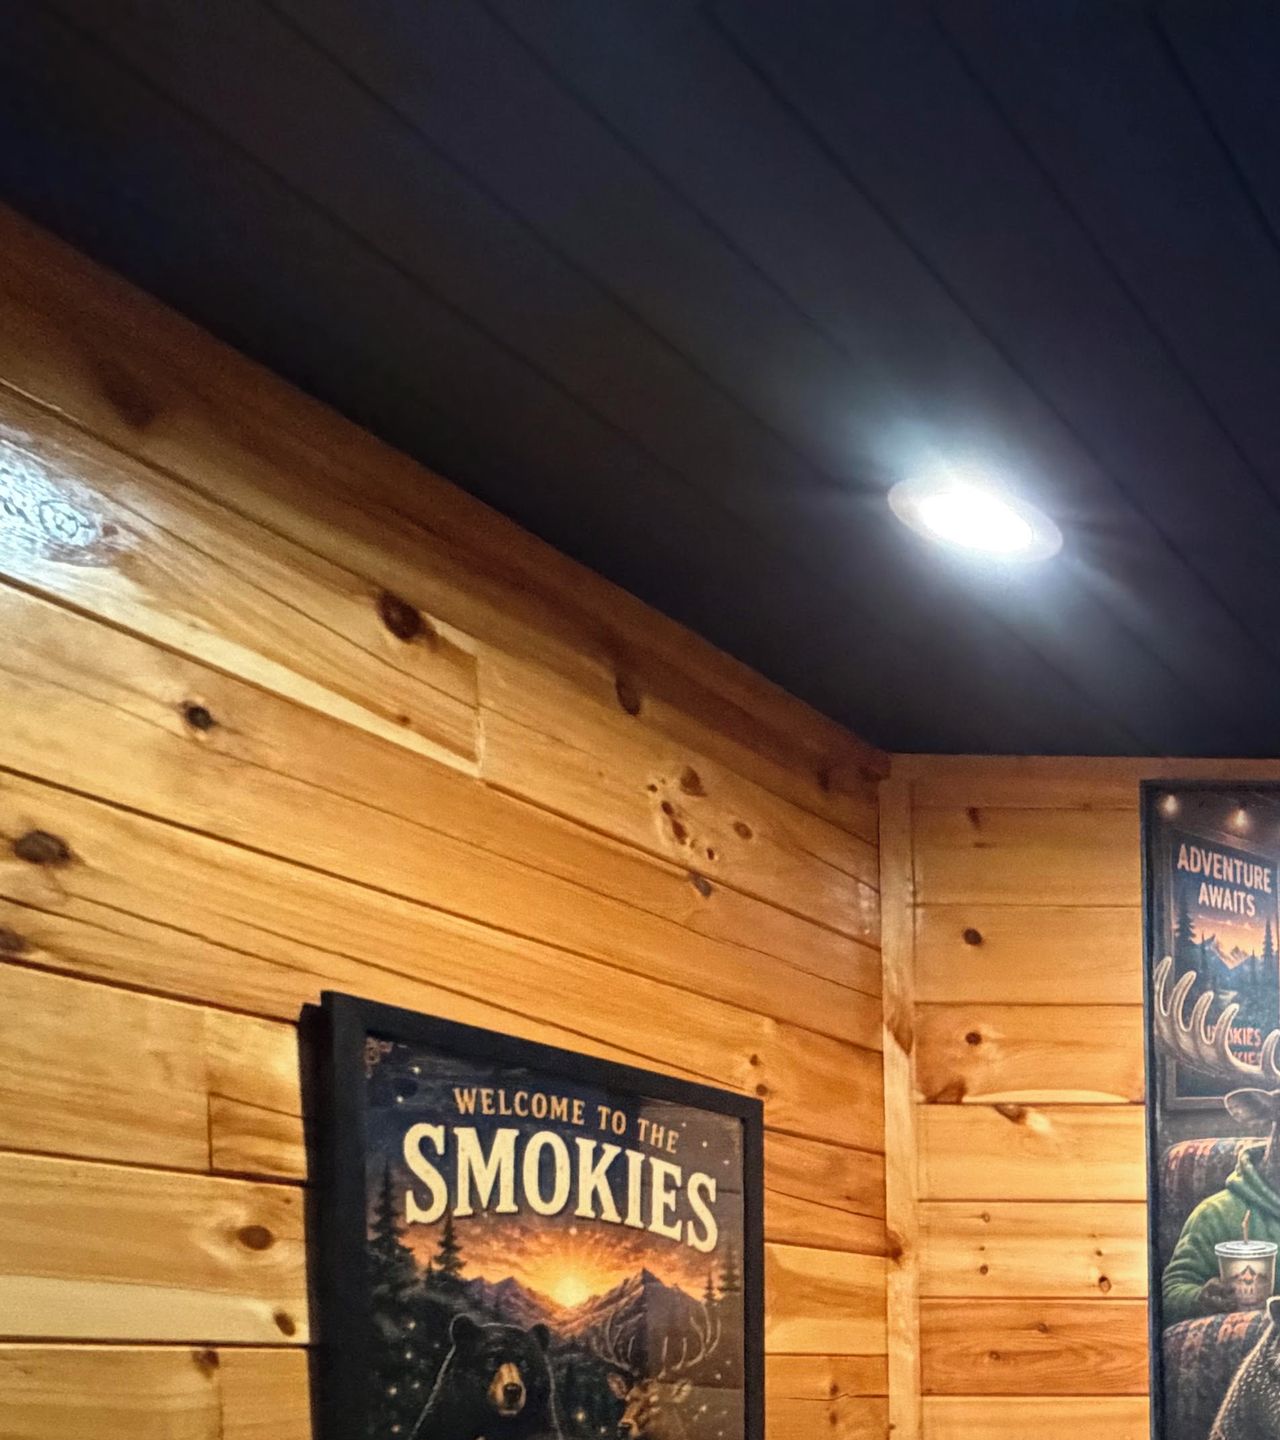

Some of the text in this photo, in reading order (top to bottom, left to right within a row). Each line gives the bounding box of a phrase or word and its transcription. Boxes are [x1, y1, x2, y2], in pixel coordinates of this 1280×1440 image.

[1177, 844, 1271, 894] ADVENTURE
[1198, 882, 1256, 917] AWAITS
[453, 1087, 680, 1154] WELCOME TO THE
[403, 1122, 719, 1254] SMOKIES
